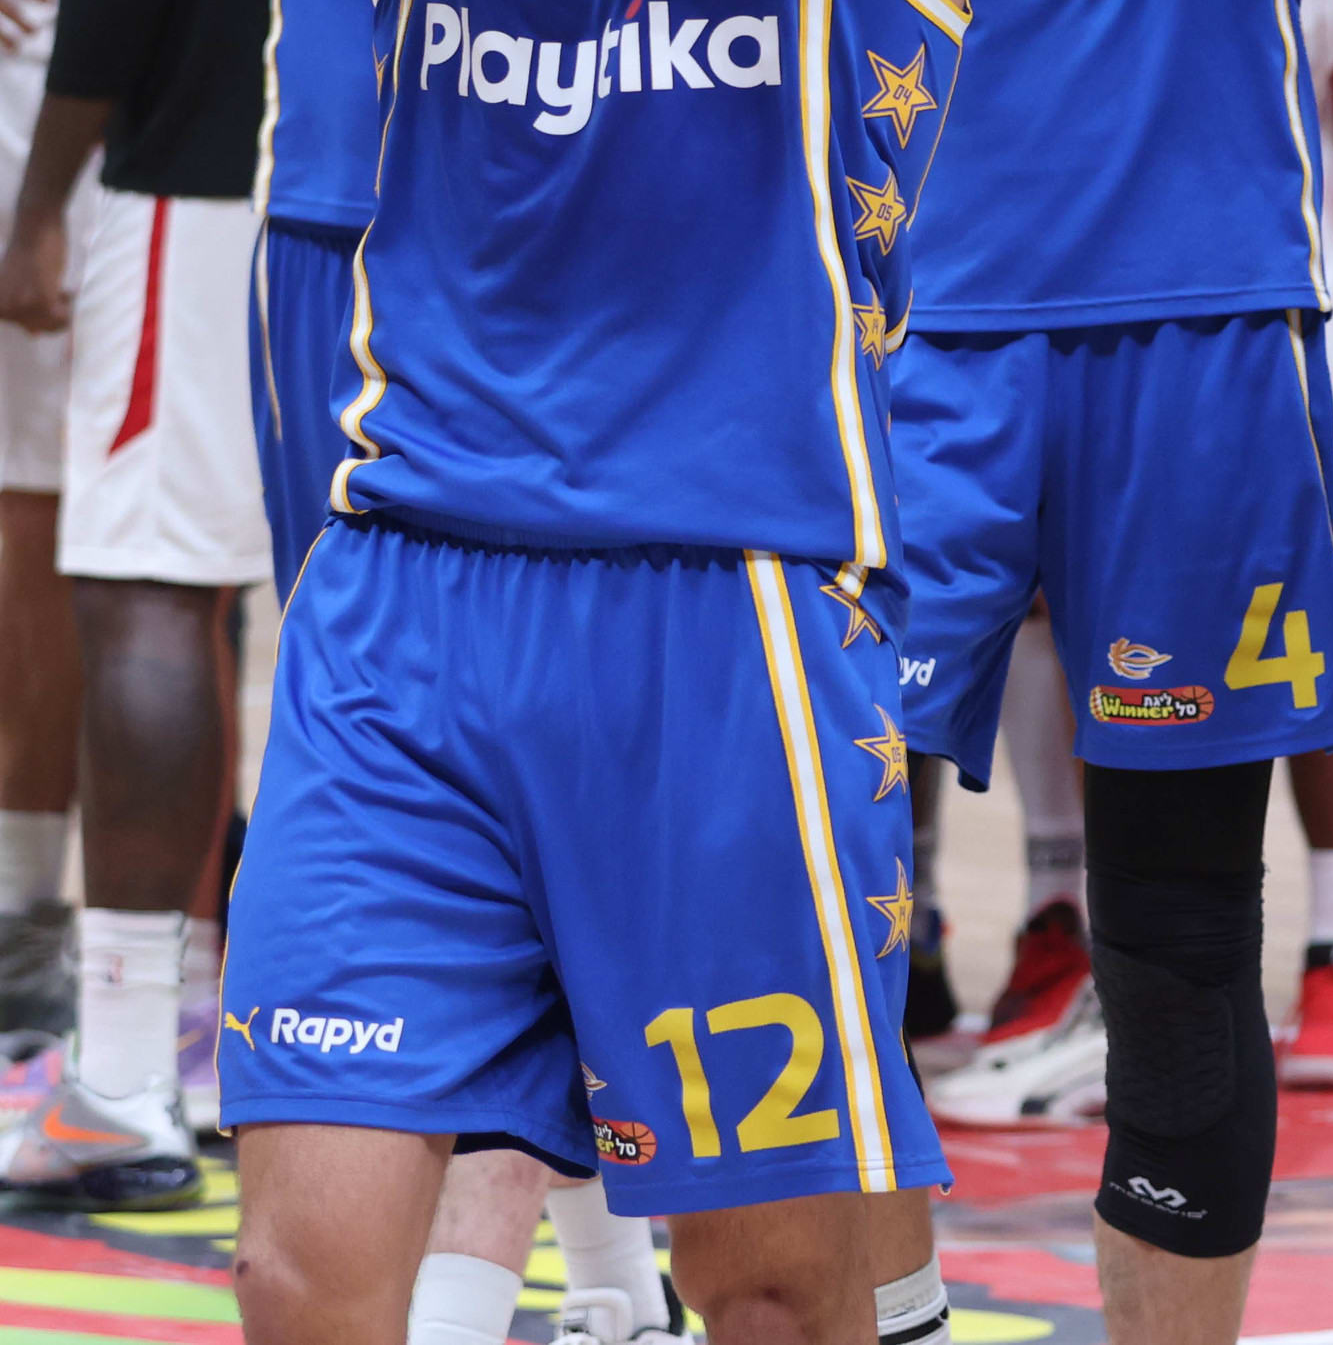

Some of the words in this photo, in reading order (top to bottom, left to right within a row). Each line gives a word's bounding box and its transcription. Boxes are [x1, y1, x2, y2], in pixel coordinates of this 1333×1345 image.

[1224, 583, 1325, 709] 4
[1102, 695, 1174, 719] Winner
[270, 1007, 404, 1054] Rapyd
[645, 992, 840, 1157] 12
